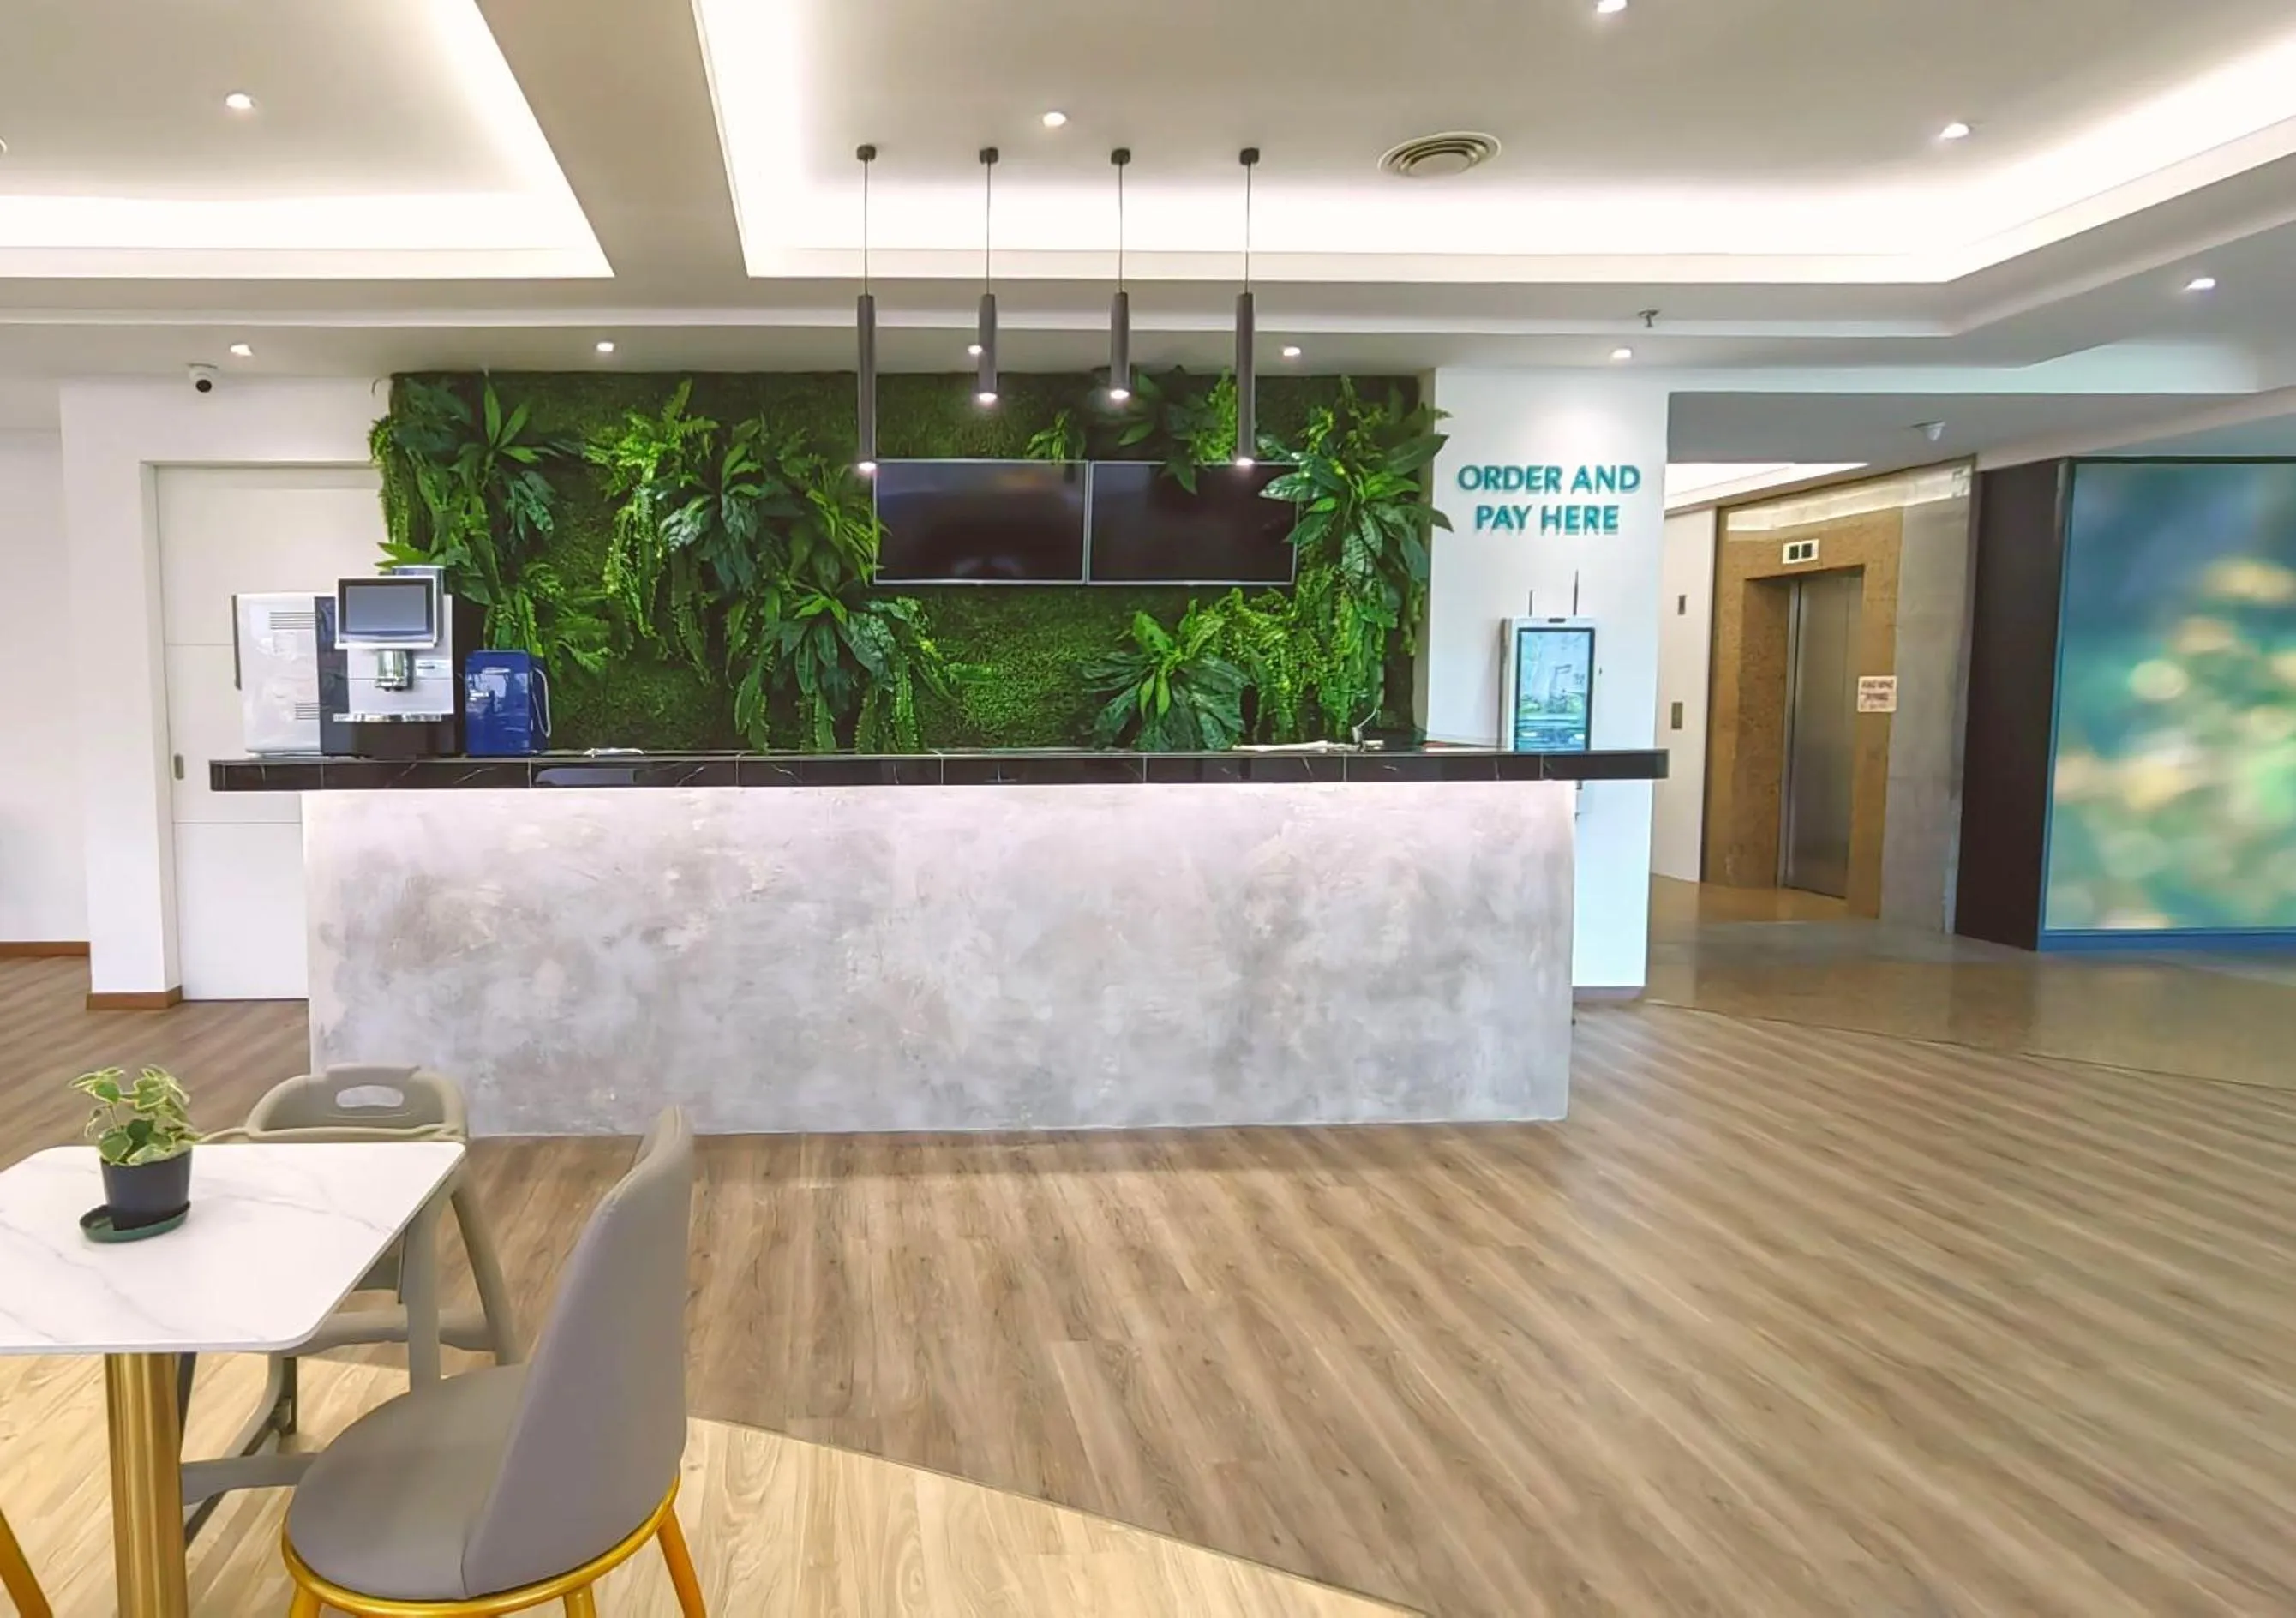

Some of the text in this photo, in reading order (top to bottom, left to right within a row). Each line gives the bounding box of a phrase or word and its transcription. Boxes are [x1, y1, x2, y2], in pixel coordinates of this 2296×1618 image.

[1457, 464, 1641, 494] ORDER AND
[1475, 505, 1619, 535] PAY HERE
